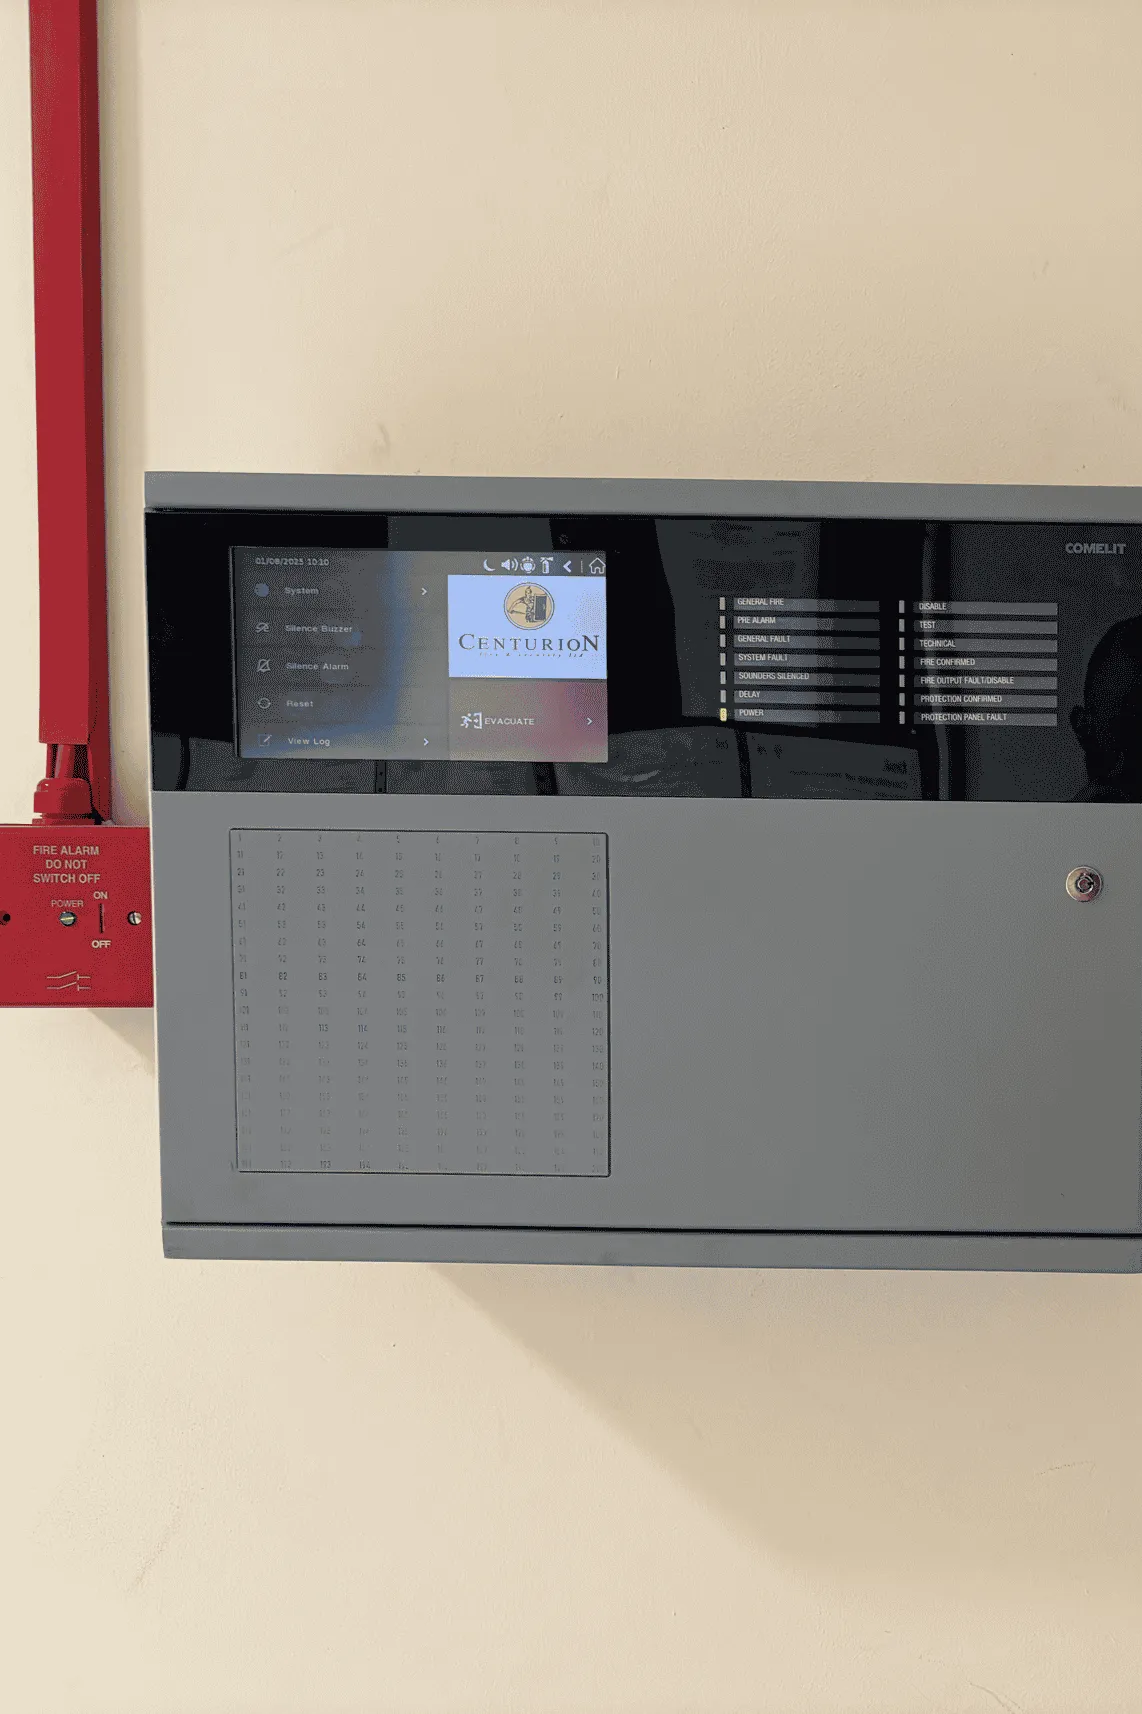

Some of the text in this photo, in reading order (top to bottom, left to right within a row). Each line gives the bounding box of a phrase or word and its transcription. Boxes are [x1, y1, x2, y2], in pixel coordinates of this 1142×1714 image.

[1065, 542, 1126, 554] COMELIT
[284, 587, 319, 596] System
[458, 634, 599, 651] CENTURION
[314, 738, 330, 747] Log
[33, 845, 99, 855] FIRE ALARM
[46, 860, 87, 869] DO NOT
[33, 874, 100, 884] SWITCH OFF
[94, 891, 108, 899] ON
[92, 940, 111, 948] OFF
